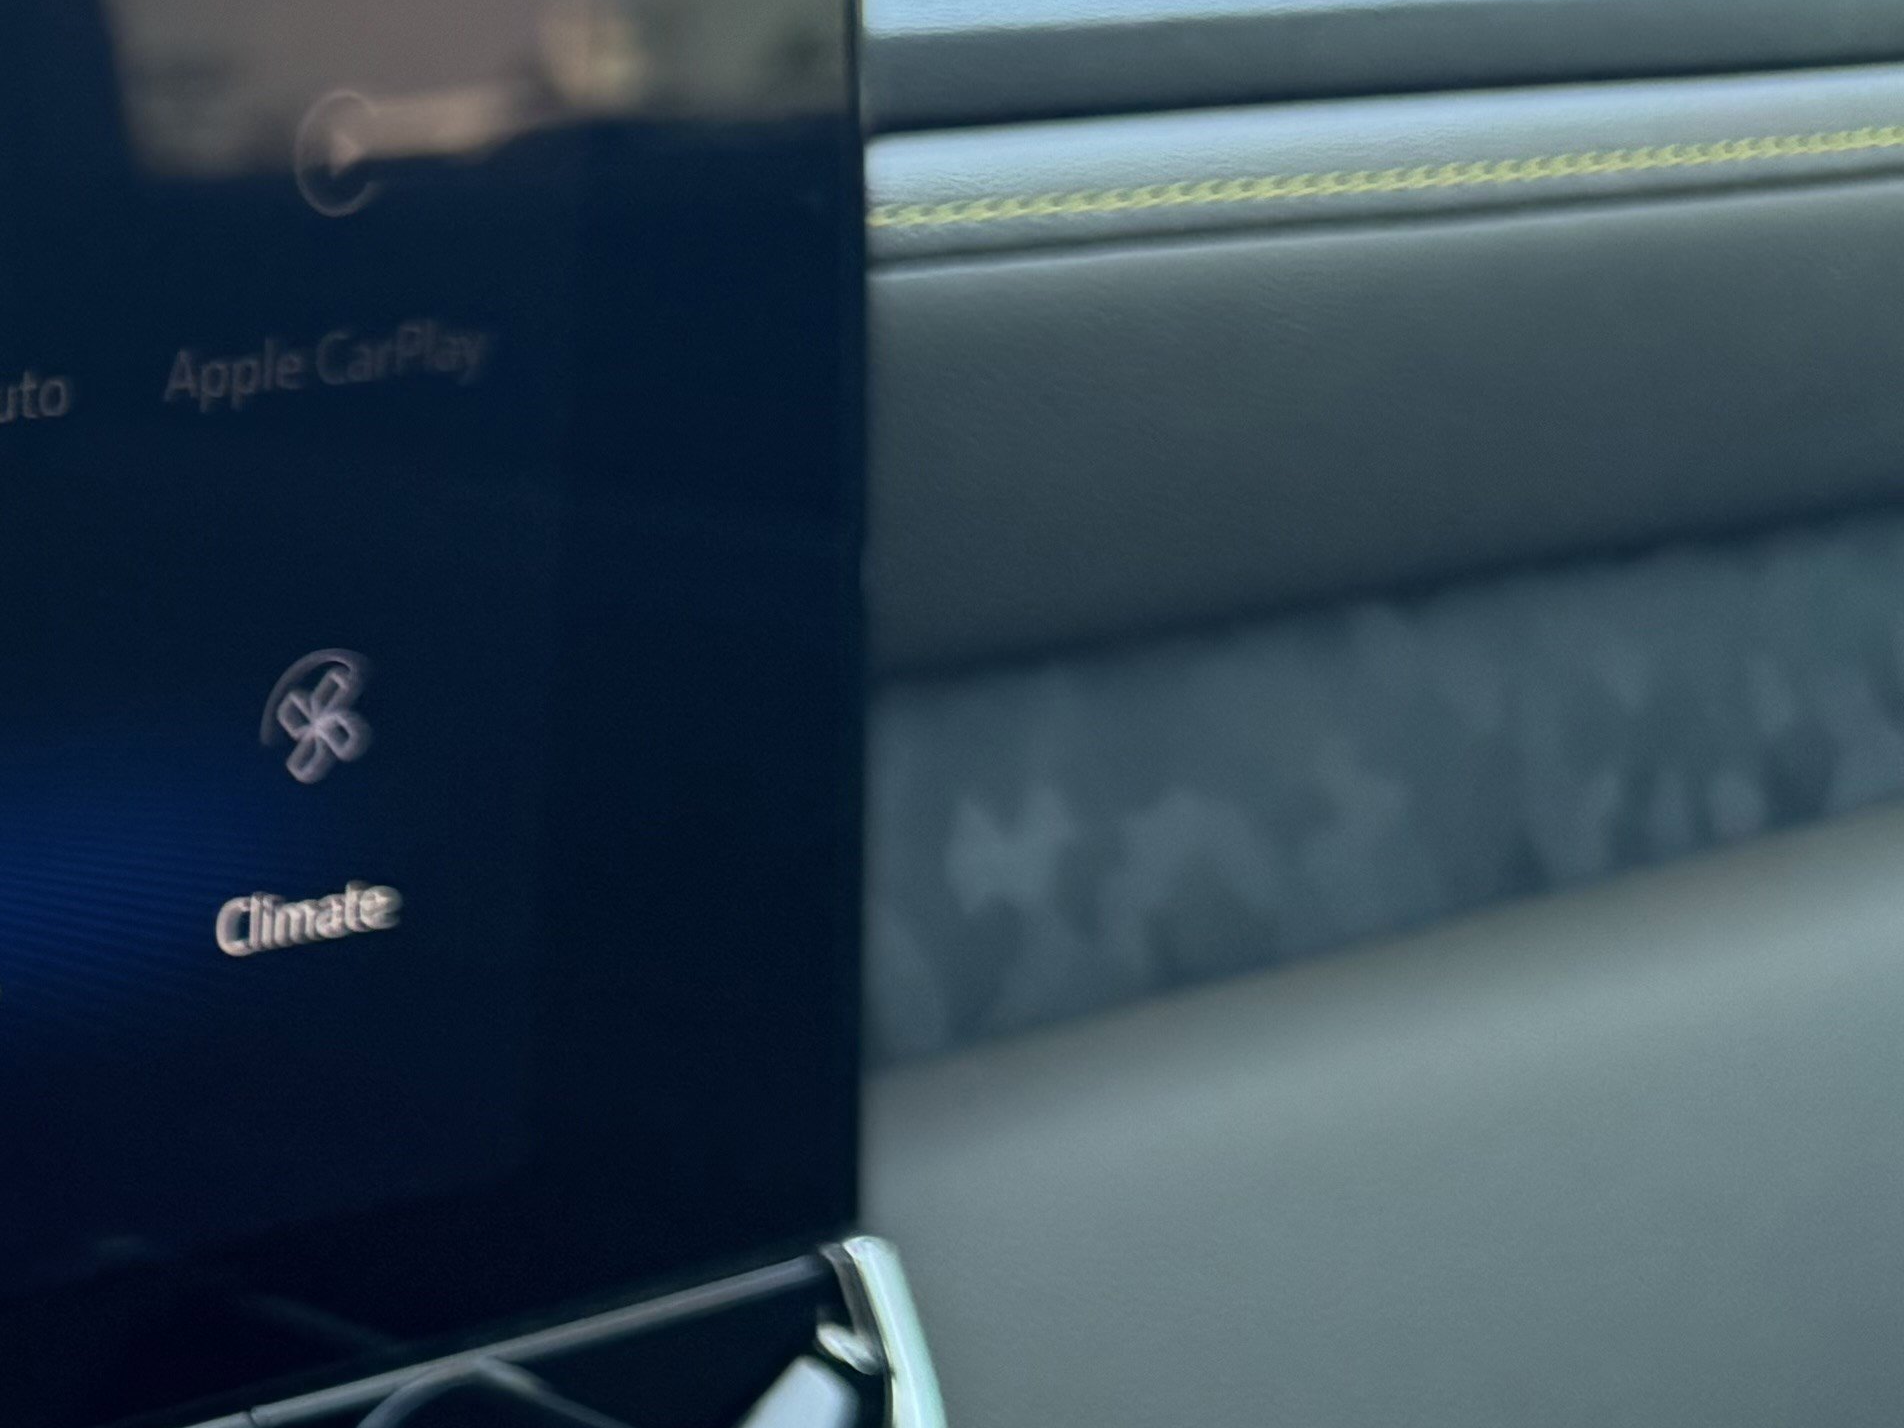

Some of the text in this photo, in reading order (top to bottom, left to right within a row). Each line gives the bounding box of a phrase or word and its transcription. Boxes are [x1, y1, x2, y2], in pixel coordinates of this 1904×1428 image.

[163, 320, 488, 412] Apple CarPlay
[214, 881, 401, 958] Climate
